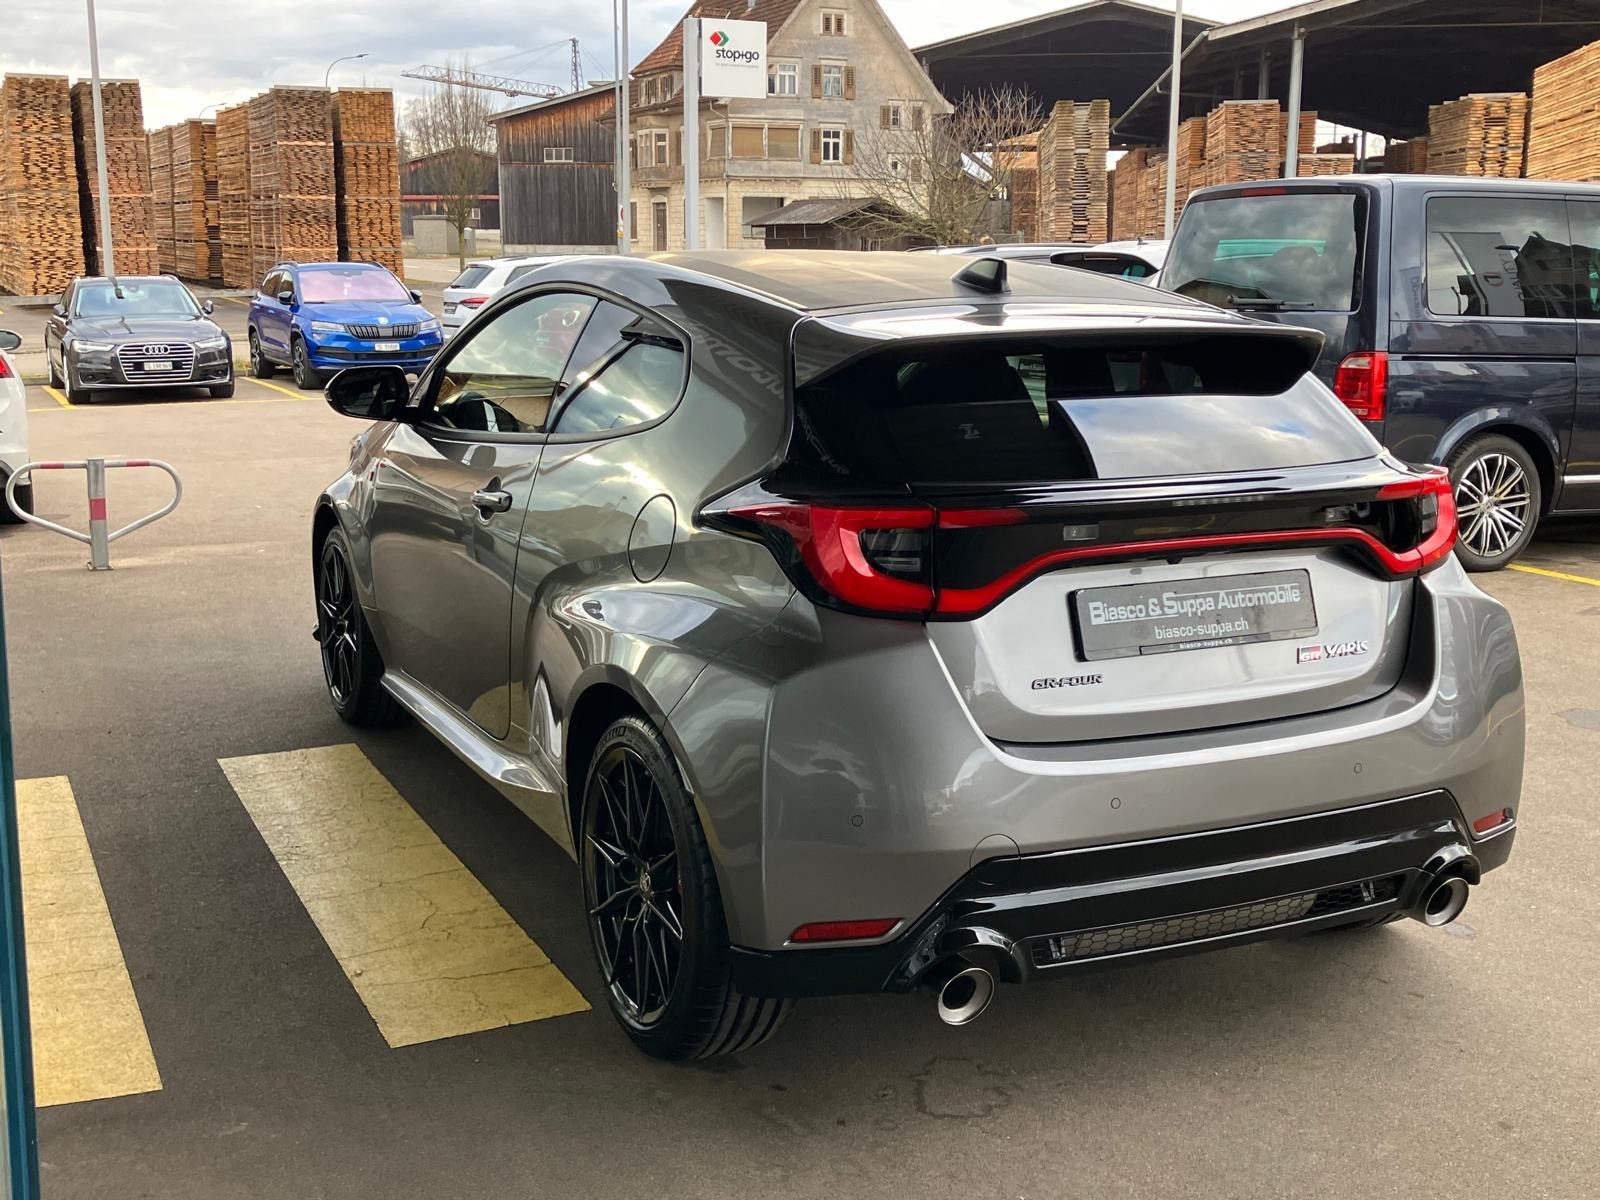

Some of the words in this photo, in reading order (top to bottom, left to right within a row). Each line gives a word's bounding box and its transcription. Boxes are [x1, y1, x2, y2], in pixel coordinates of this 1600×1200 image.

[715, 48, 760, 63] stop+go
[1088, 601, 1146, 625] Biasco
[1148, 598, 1163, 616] &
[1162, 592, 1215, 617] Suppa
[1217, 583, 1301, 610] Automobile
[1154, 617, 1249, 640] biasco-suppa.ch
[1323, 640, 1369, 659] YARIS
